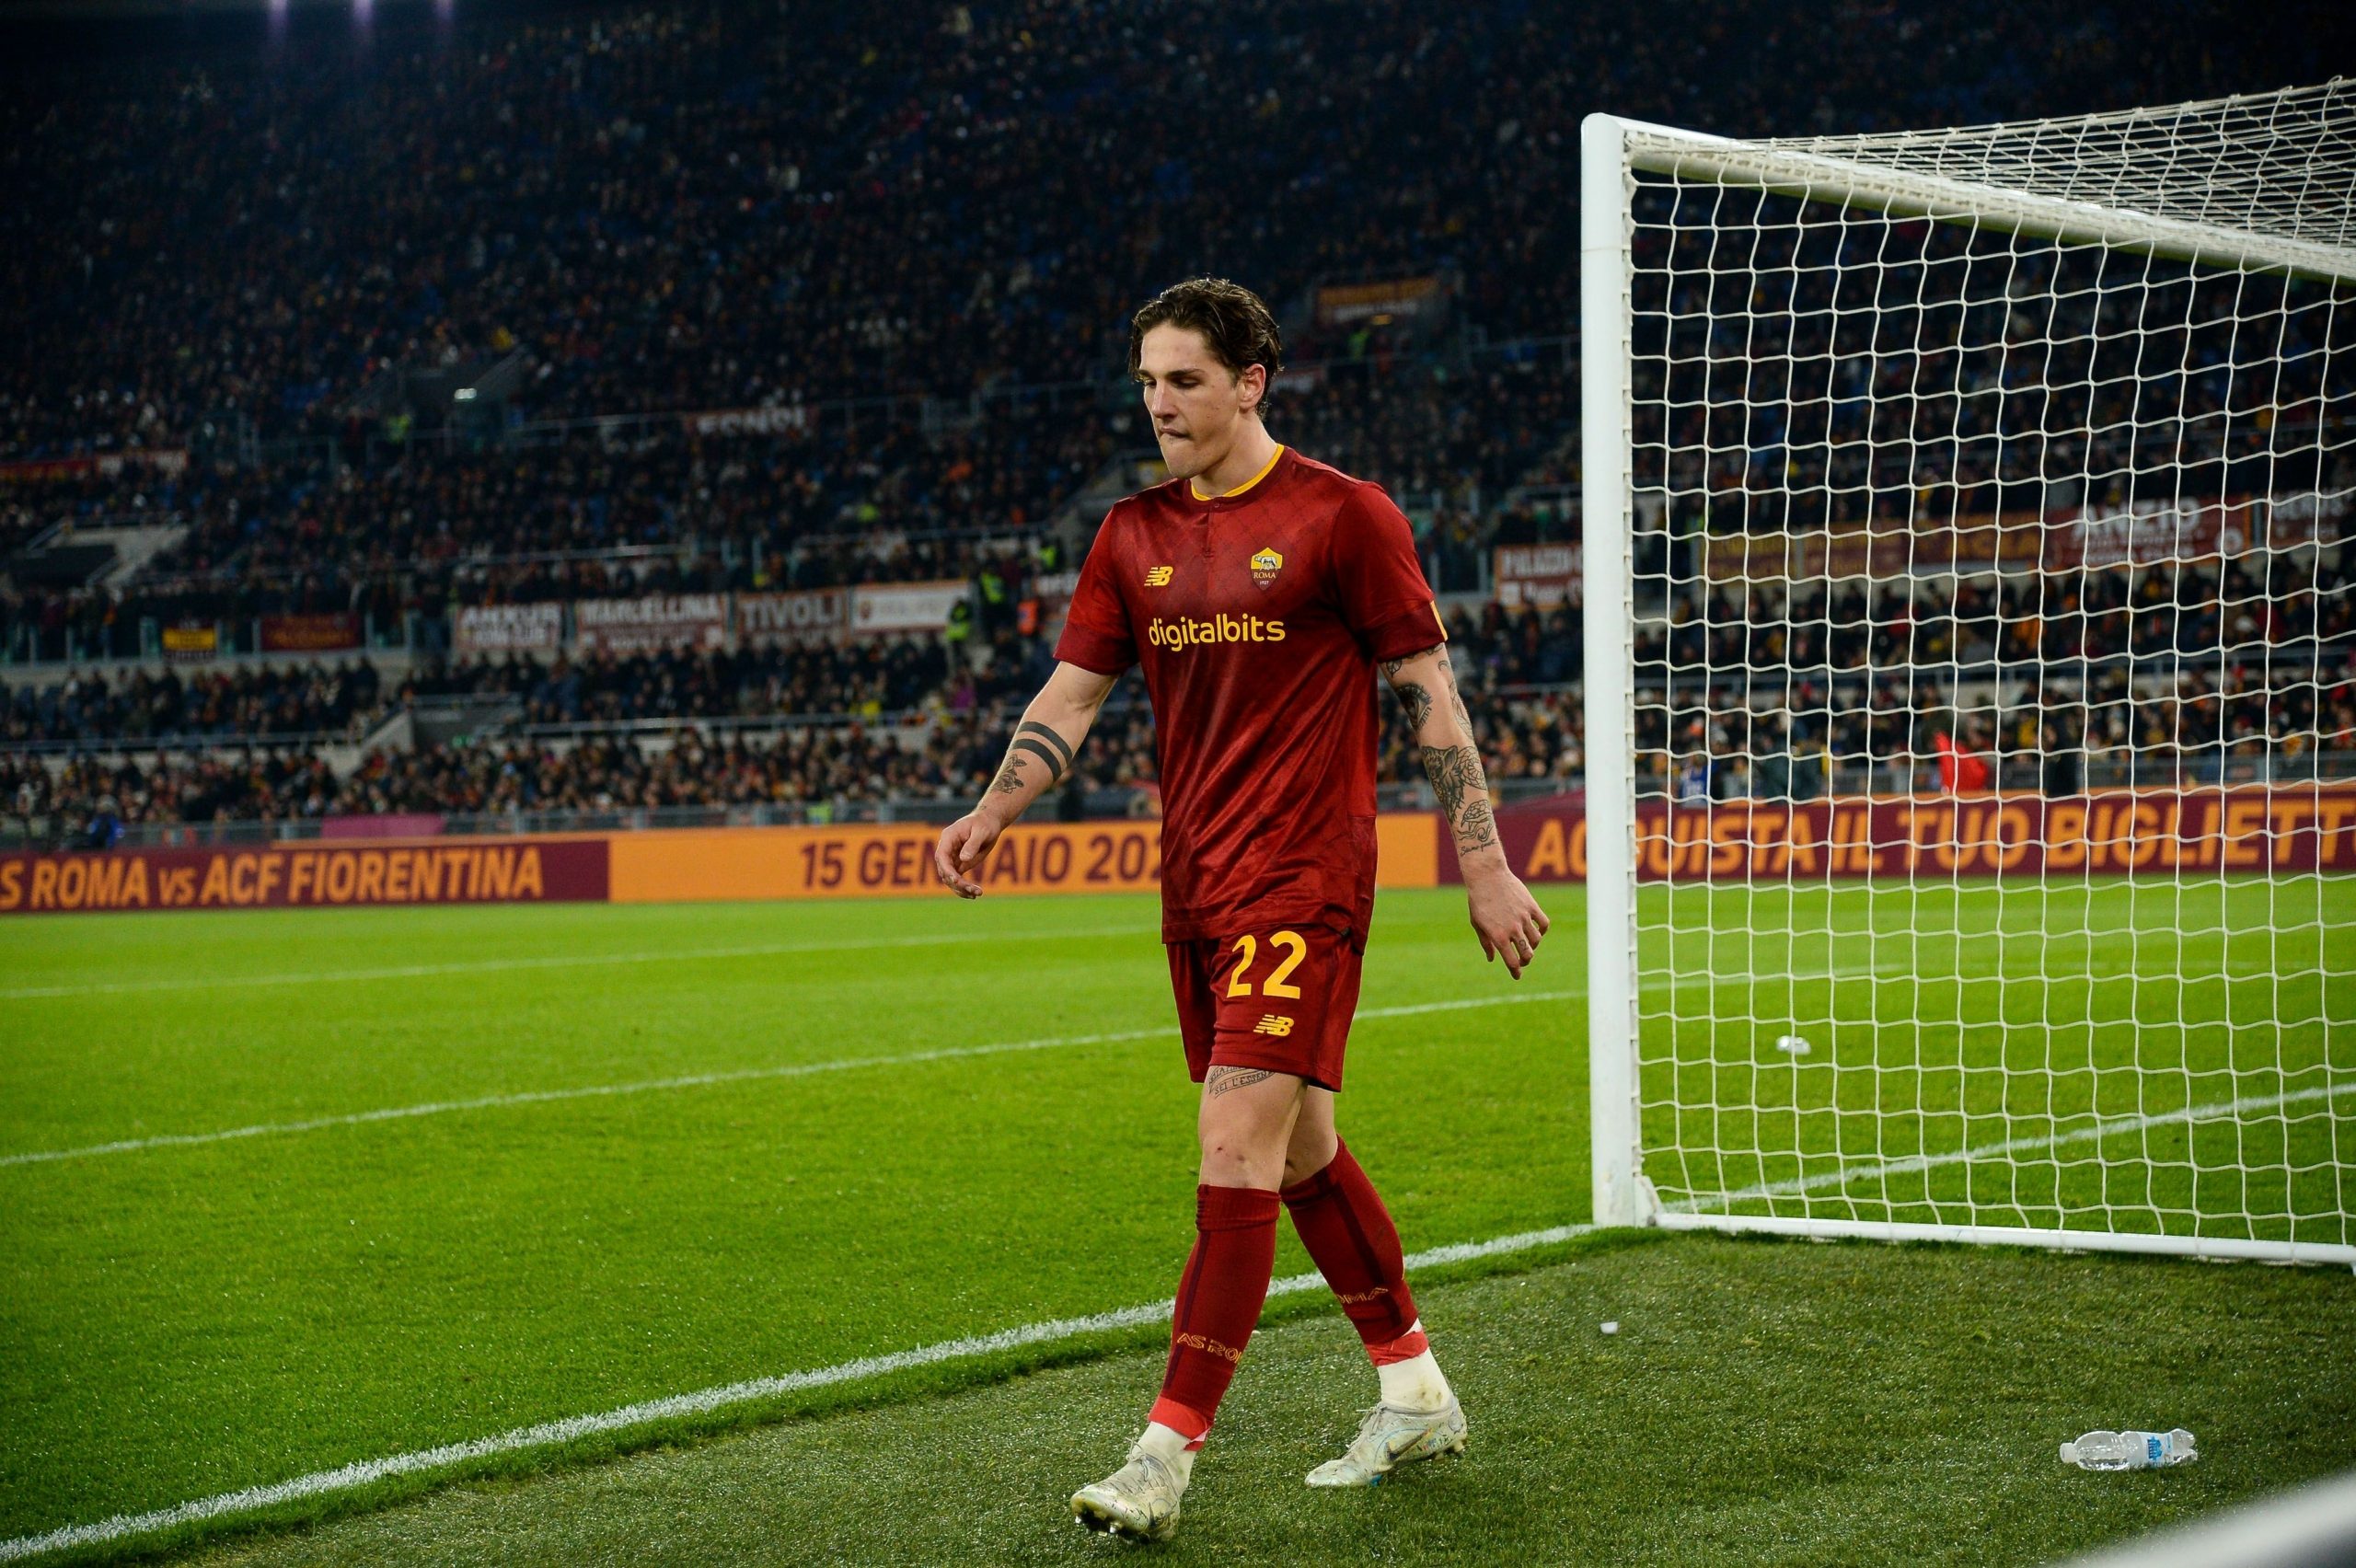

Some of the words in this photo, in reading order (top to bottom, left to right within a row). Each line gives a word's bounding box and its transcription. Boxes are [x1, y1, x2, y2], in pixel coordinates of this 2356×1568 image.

[742, 594, 844, 631] TIVOLI
[1149, 613, 1286, 651] digitalbits
[799, 839, 846, 887] 15
[859, 832, 1072, 886] GENAIO
[1829, 812, 1884, 871] IL
[1896, 806, 2030, 870] TUO
[2045, 798, 2356, 868] BIGLIETT
[30, 856, 149, 907] ROMA
[157, 867, 196, 905] vs
[201, 852, 283, 905] ACF
[288, 846, 543, 902] FIORENTINA
[1227, 930, 1307, 999] 22
[1177, 1332, 1207, 1349] AS
